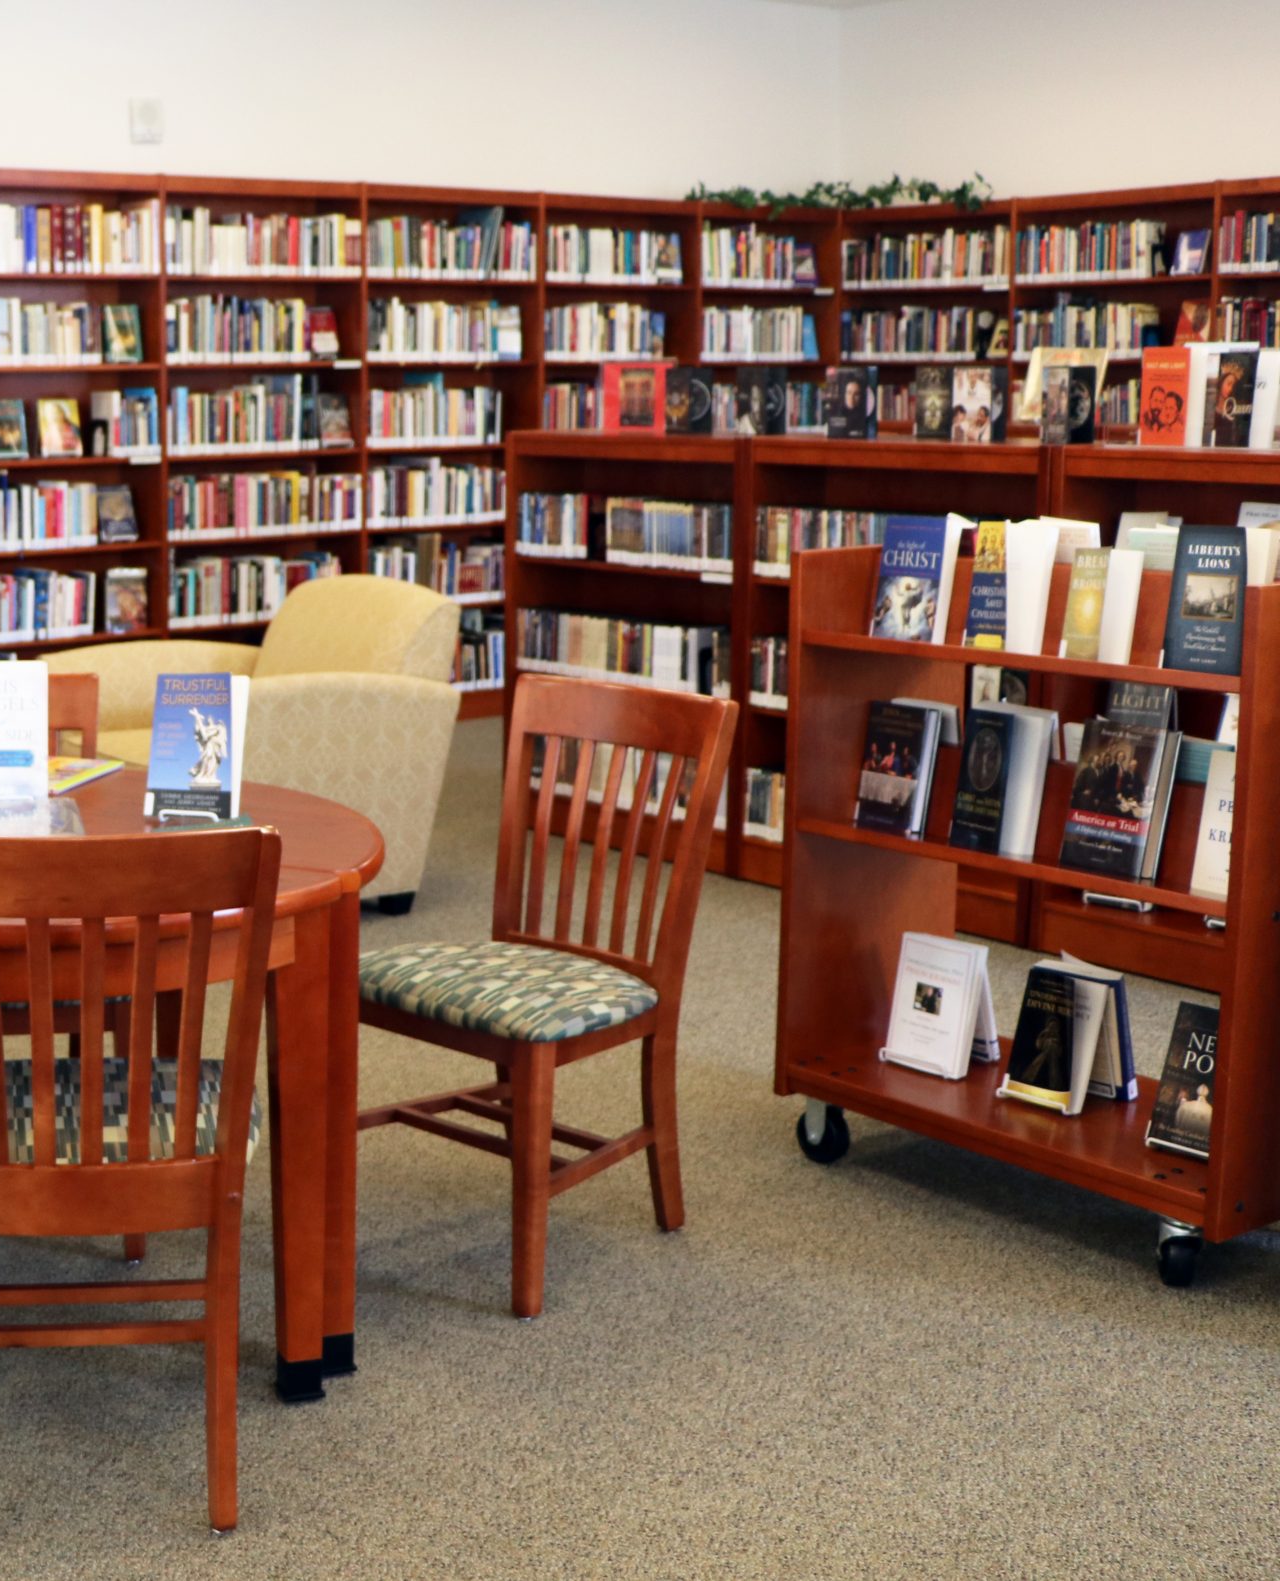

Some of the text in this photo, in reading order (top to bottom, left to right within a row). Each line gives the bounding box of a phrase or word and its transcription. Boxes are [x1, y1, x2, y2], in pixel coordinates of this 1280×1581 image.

[1187, 544, 1241, 557] LIBERTY'S
[883, 549, 941, 570] CHRIST
[1076, 555, 1108, 569] BREA
[1197, 557, 1231, 569] LIONS
[163, 678, 228, 692] TRUSTFUL
[161, 693, 229, 706] SURRENDER
[1113, 693, 1160, 710] LIGHT
[1218, 799, 1235, 813] PE
[1071, 811, 1106, 827] America
[1118, 819, 1140, 833] Trial
[1208, 828, 1233, 844] KR
[1187, 1031, 1217, 1054] NE
[1182, 1050, 1215, 1074] PO
